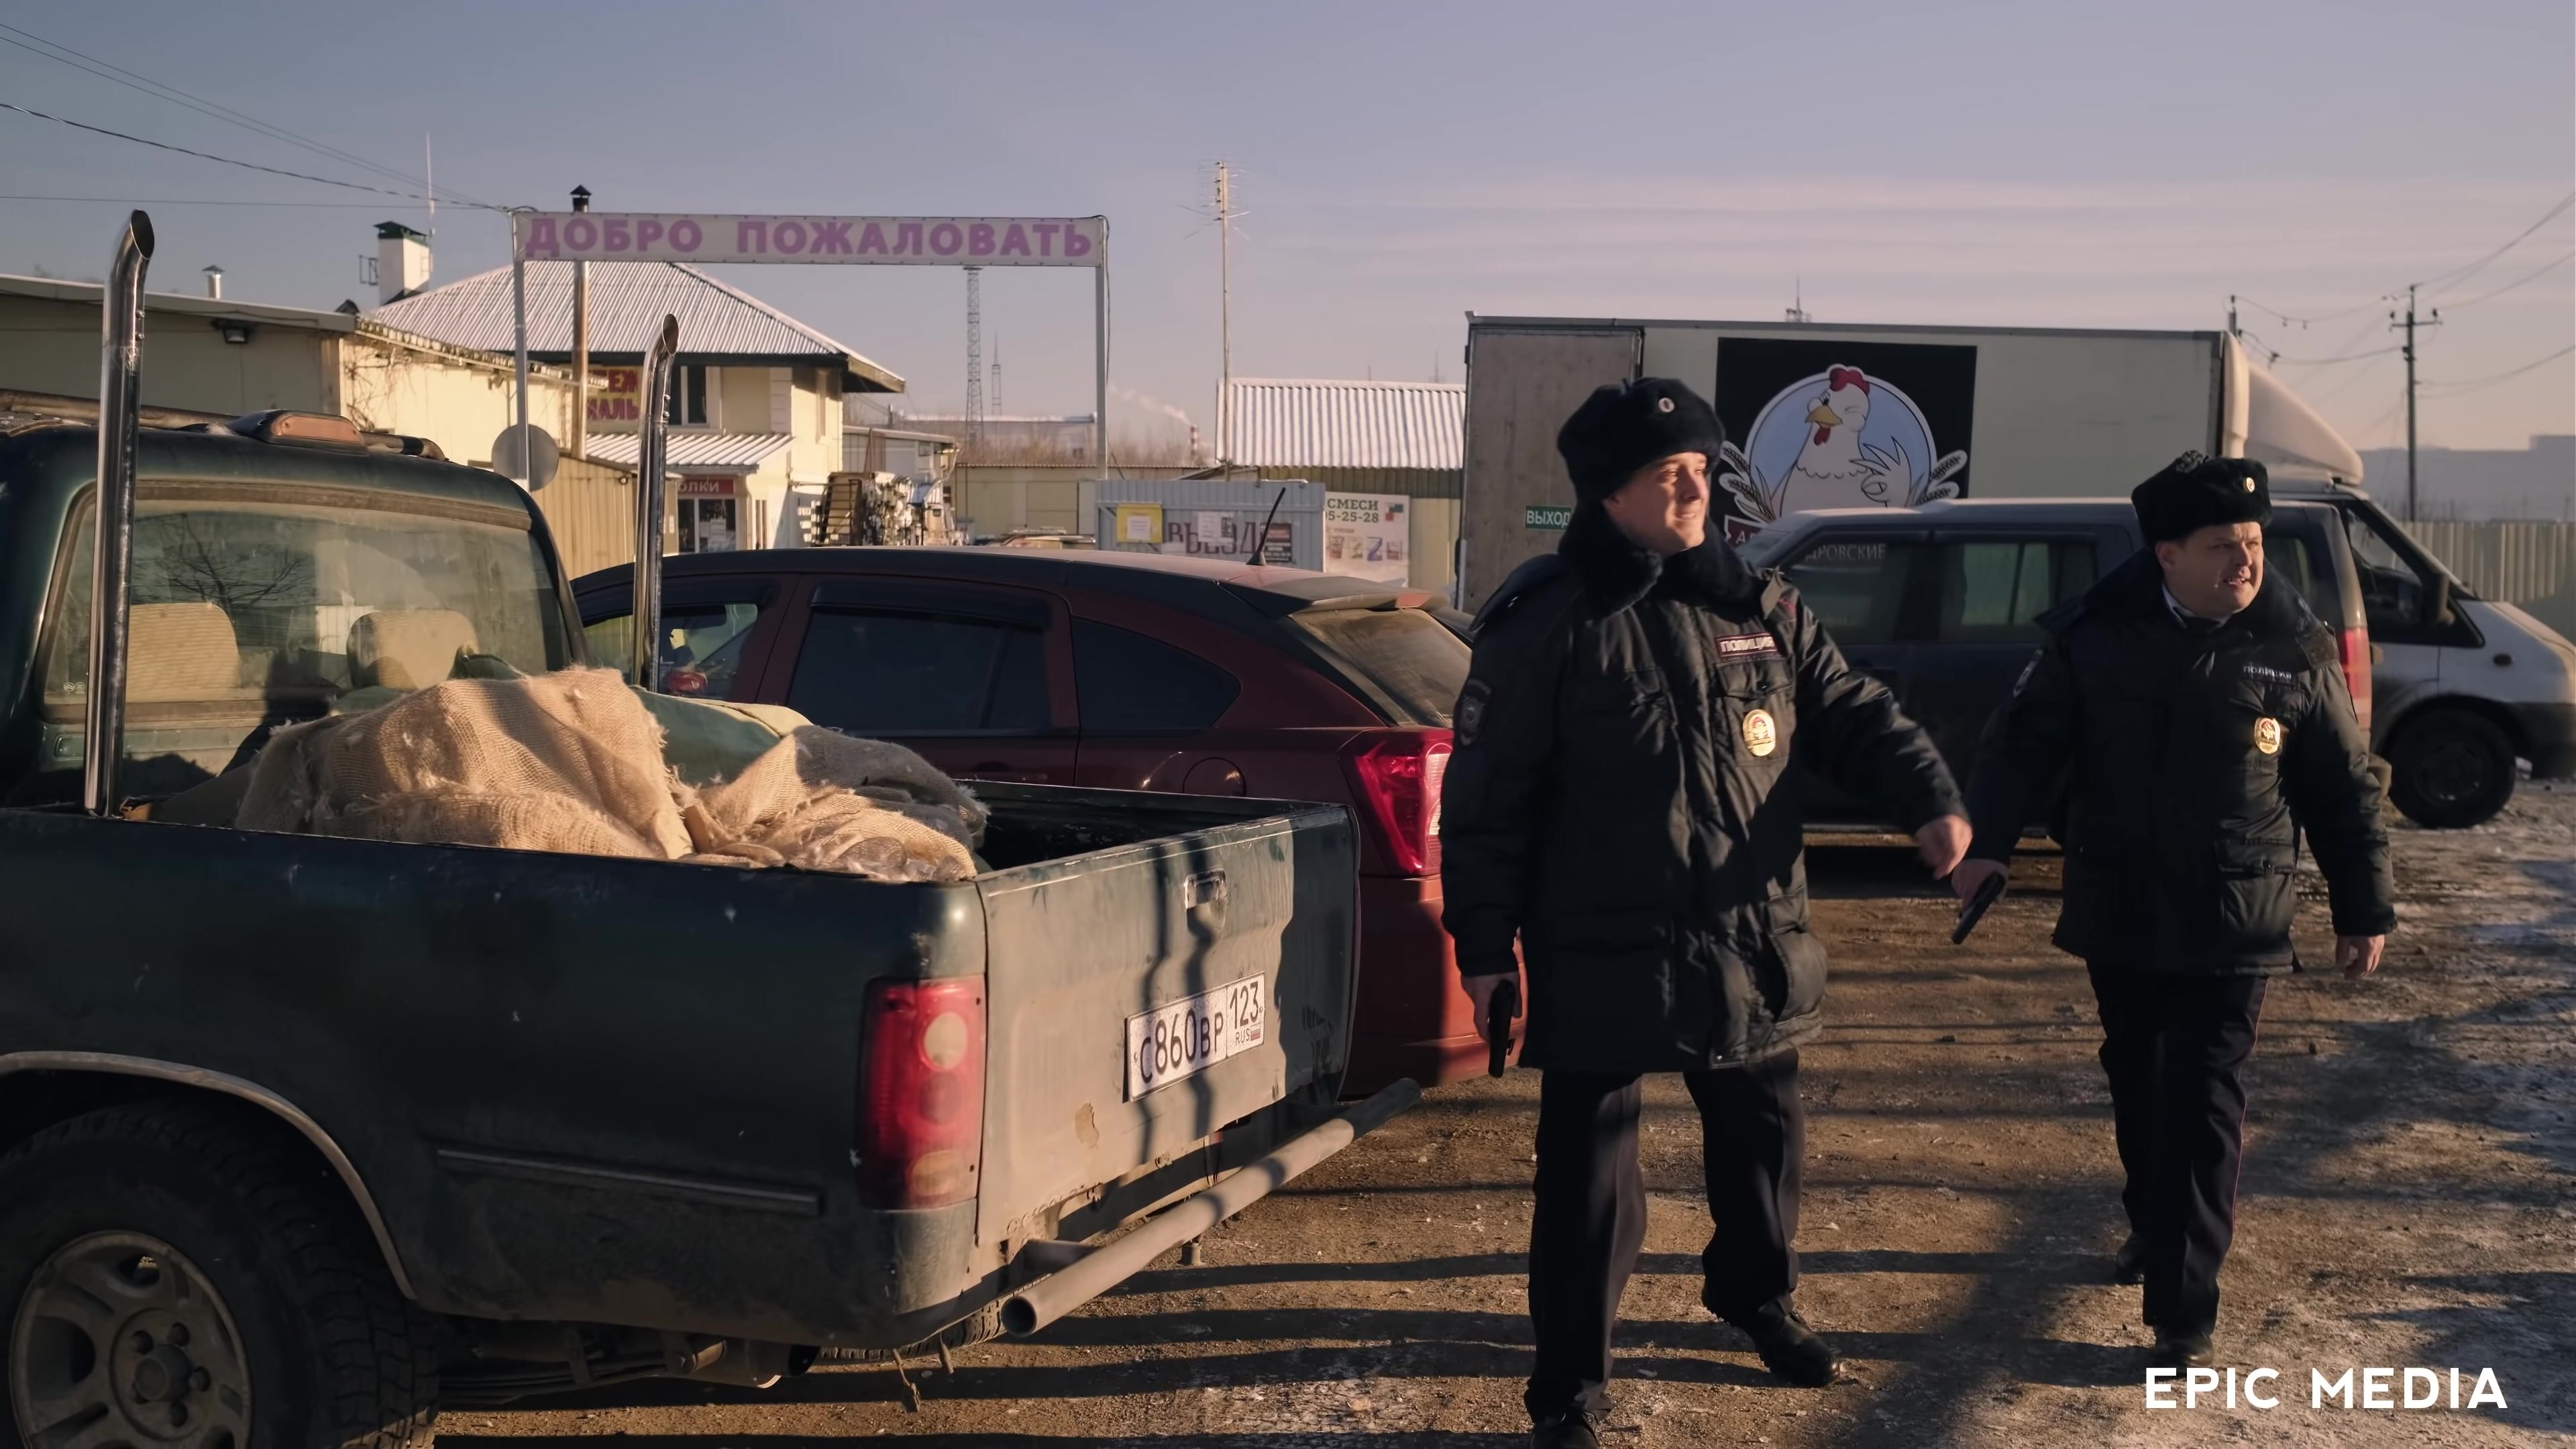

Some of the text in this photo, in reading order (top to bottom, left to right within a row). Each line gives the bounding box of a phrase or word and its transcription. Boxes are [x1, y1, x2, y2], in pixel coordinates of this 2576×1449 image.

[525, 217, 1092, 258] ДОБРО ПОЖАЛОВАТЬ
[1327, 498, 1379, 511] СМЕСИ
[1326, 511, 1379, 523] 5-25-28
[1526, 510, 1571, 529] ВЫХОД
[1719, 635, 1775, 652] ПОЛИЦИЯ
[1229, 981, 1259, 1030] 123
[1235, 1027, 1250, 1045] RUS
